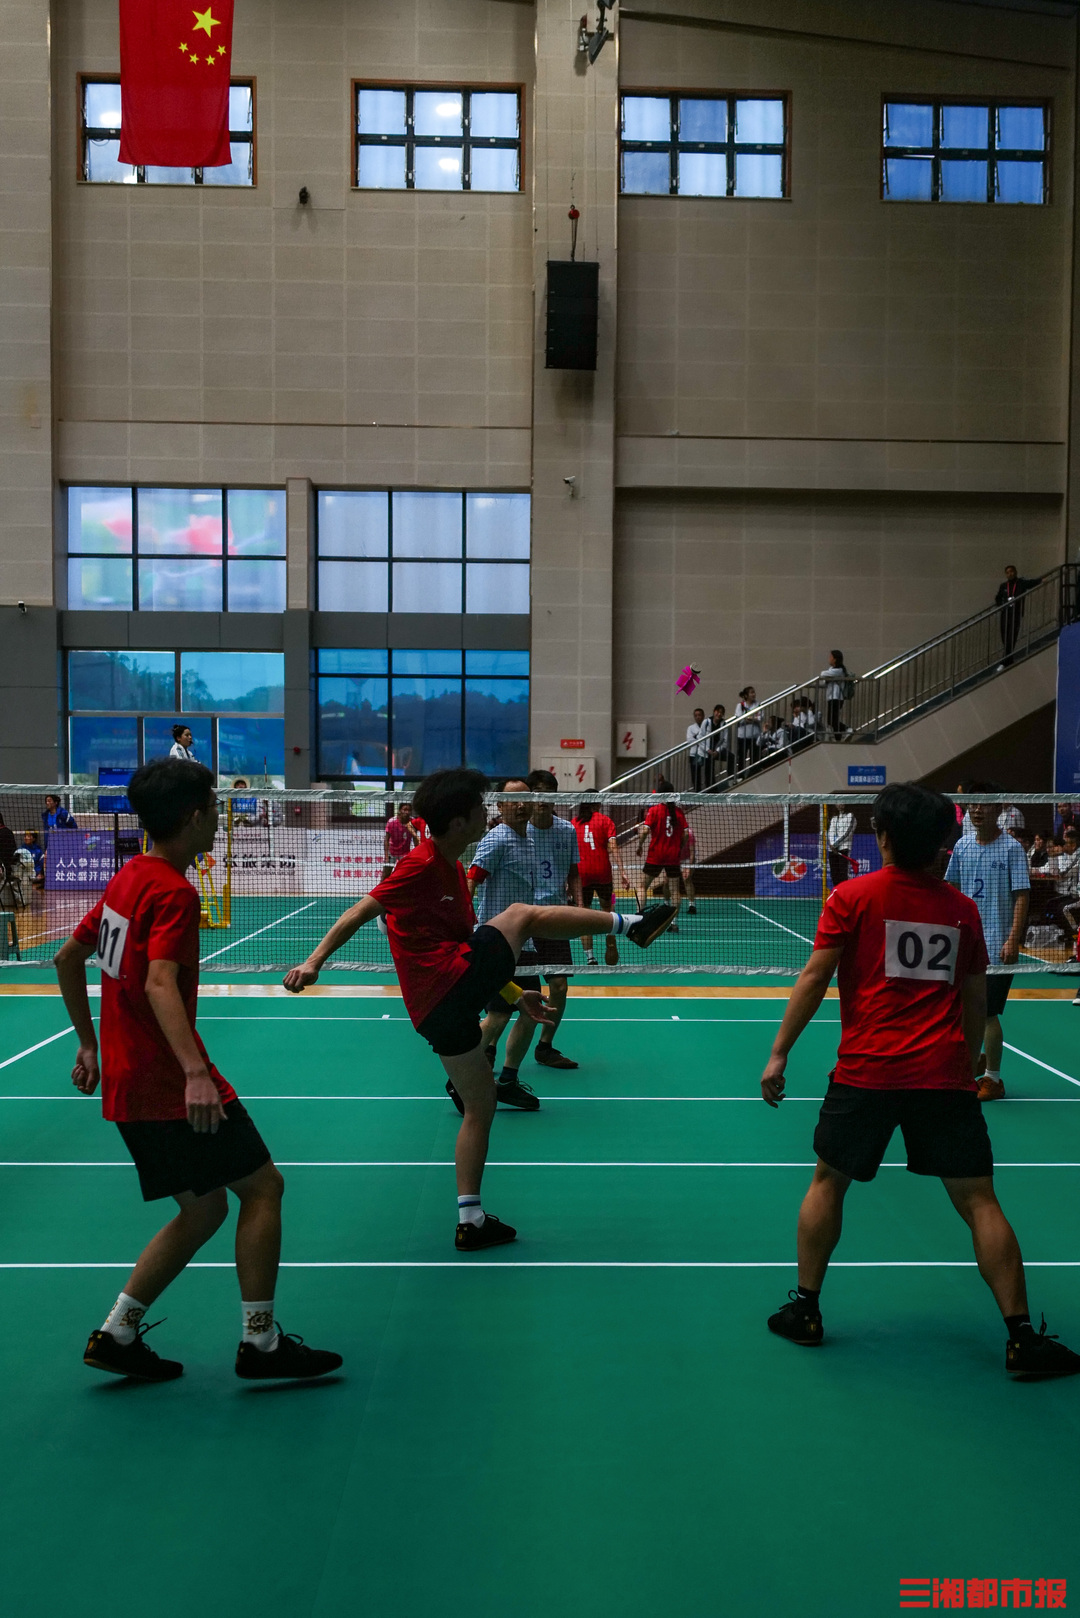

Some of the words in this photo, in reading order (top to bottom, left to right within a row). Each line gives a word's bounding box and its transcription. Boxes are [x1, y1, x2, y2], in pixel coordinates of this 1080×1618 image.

[583, 825, 595, 850] 4
[541, 861, 552, 879] 3
[973, 878, 985, 899] 2
[97, 918, 121, 967] 01
[897, 931, 952, 971] 02
